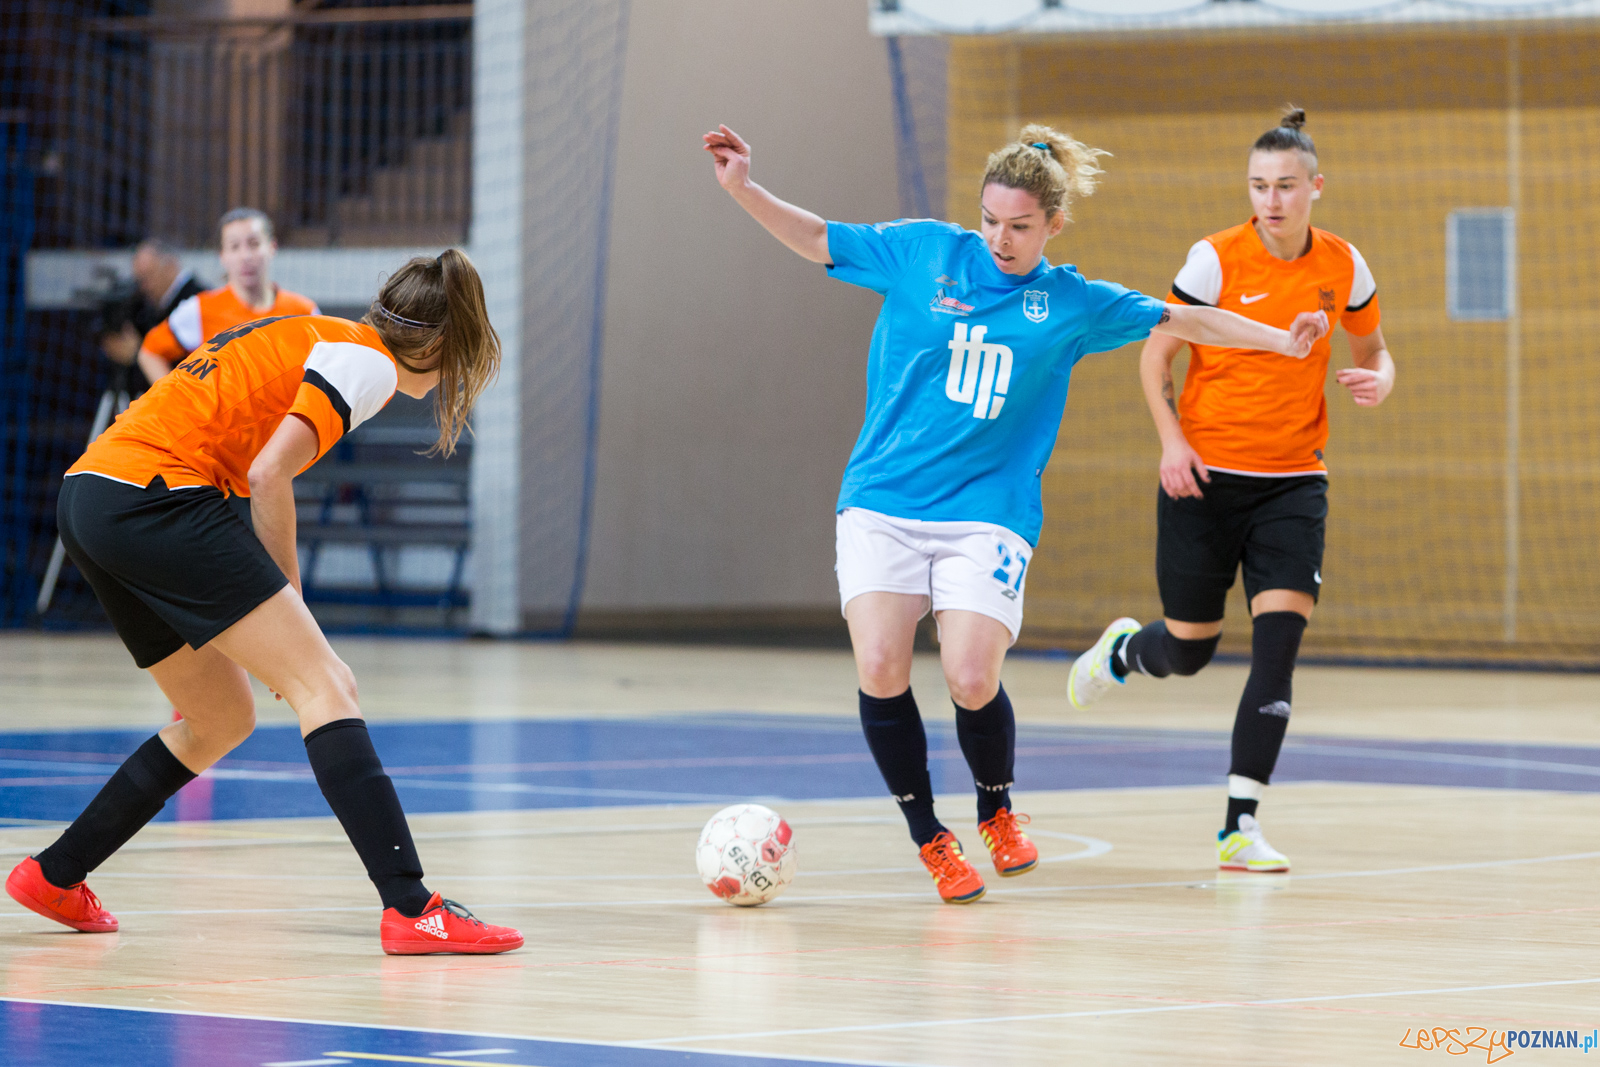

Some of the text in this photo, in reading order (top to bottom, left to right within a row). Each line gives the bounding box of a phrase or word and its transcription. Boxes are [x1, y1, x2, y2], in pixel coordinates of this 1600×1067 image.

[993, 542, 1026, 592] 27
[728, 846, 773, 892] SELECT
[414, 922, 449, 940] adidas
